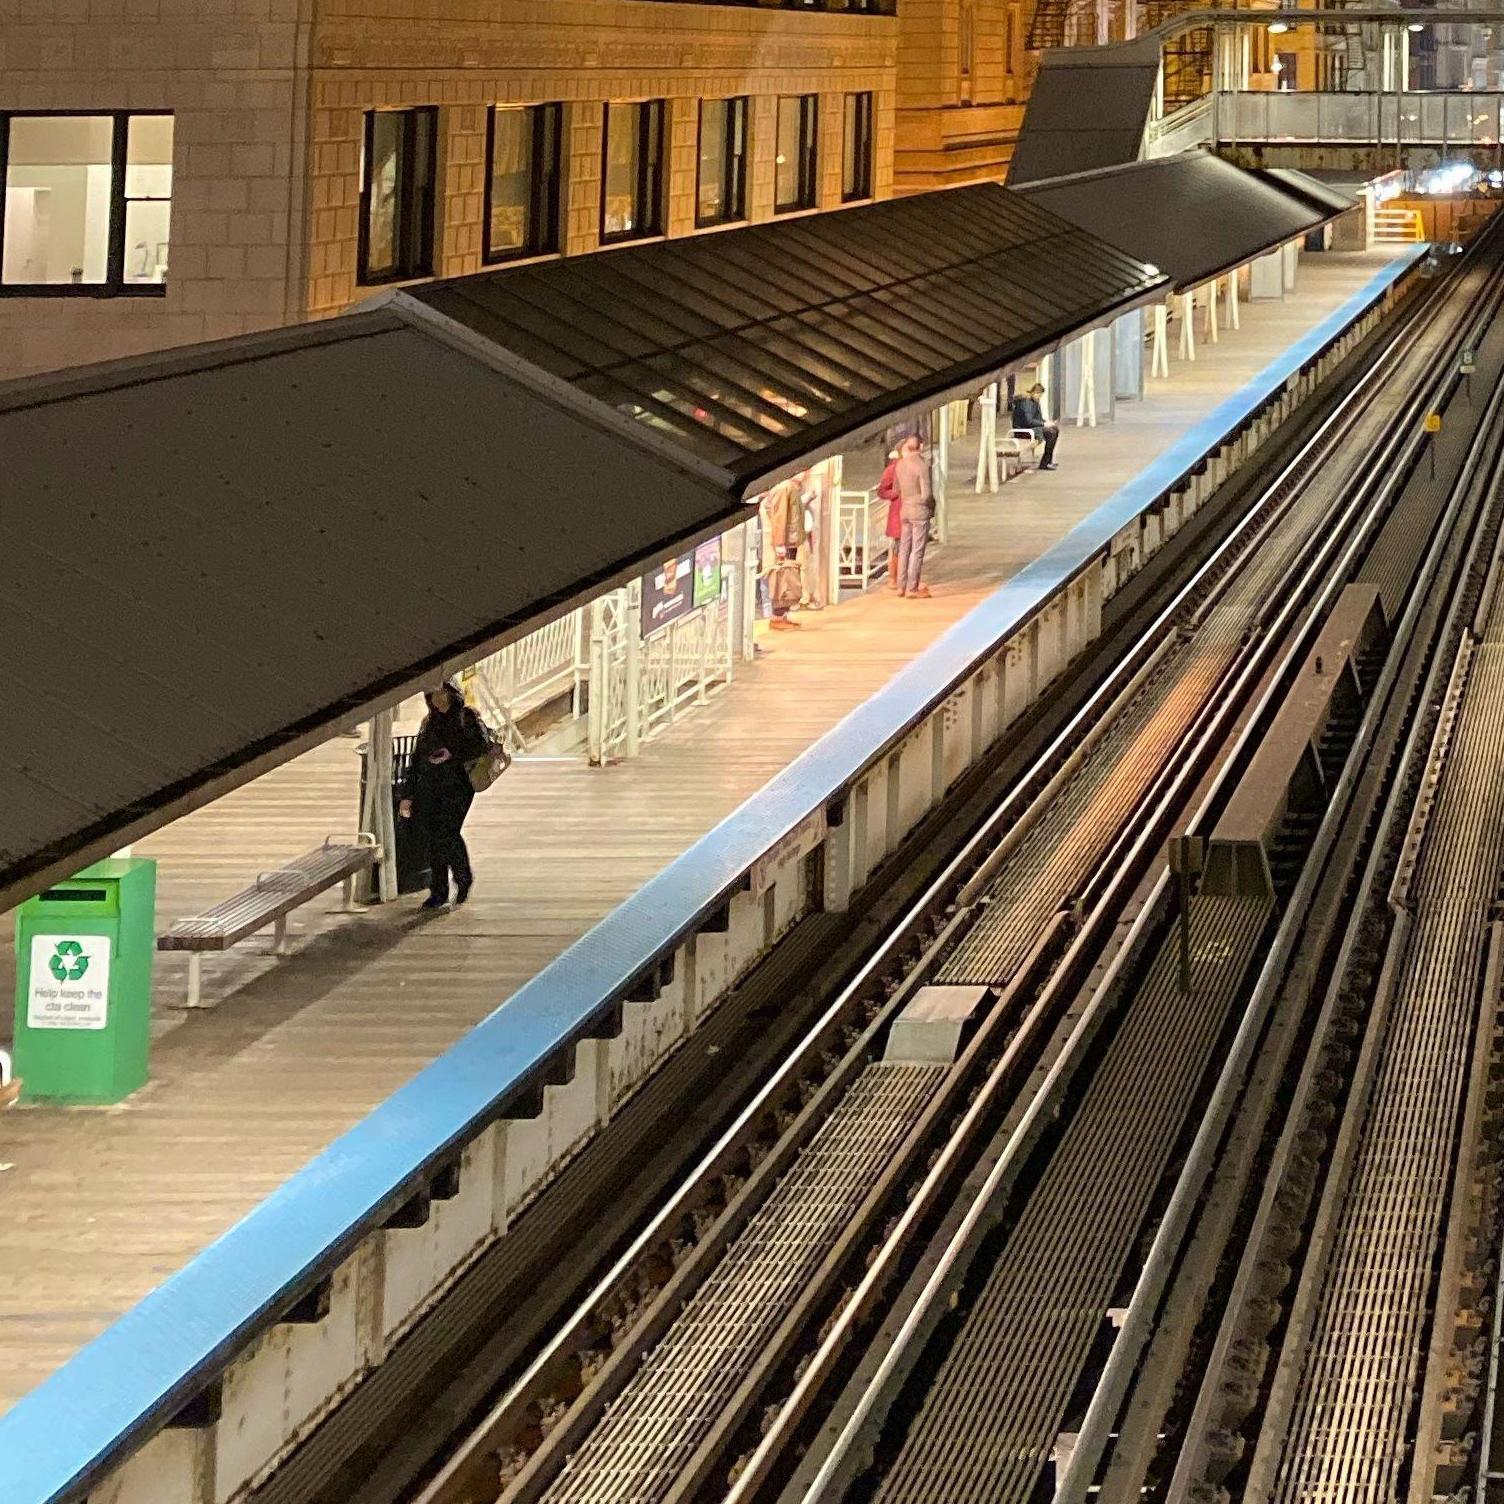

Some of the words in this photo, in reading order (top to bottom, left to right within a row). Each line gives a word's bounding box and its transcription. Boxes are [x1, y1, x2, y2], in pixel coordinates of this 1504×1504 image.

[34, 987, 58, 1000] Help
[60, 988, 85, 1000] keep
[87, 989, 103, 1000] the
[44, 1002, 61, 1012] cta
[63, 1001, 92, 1012] clean
